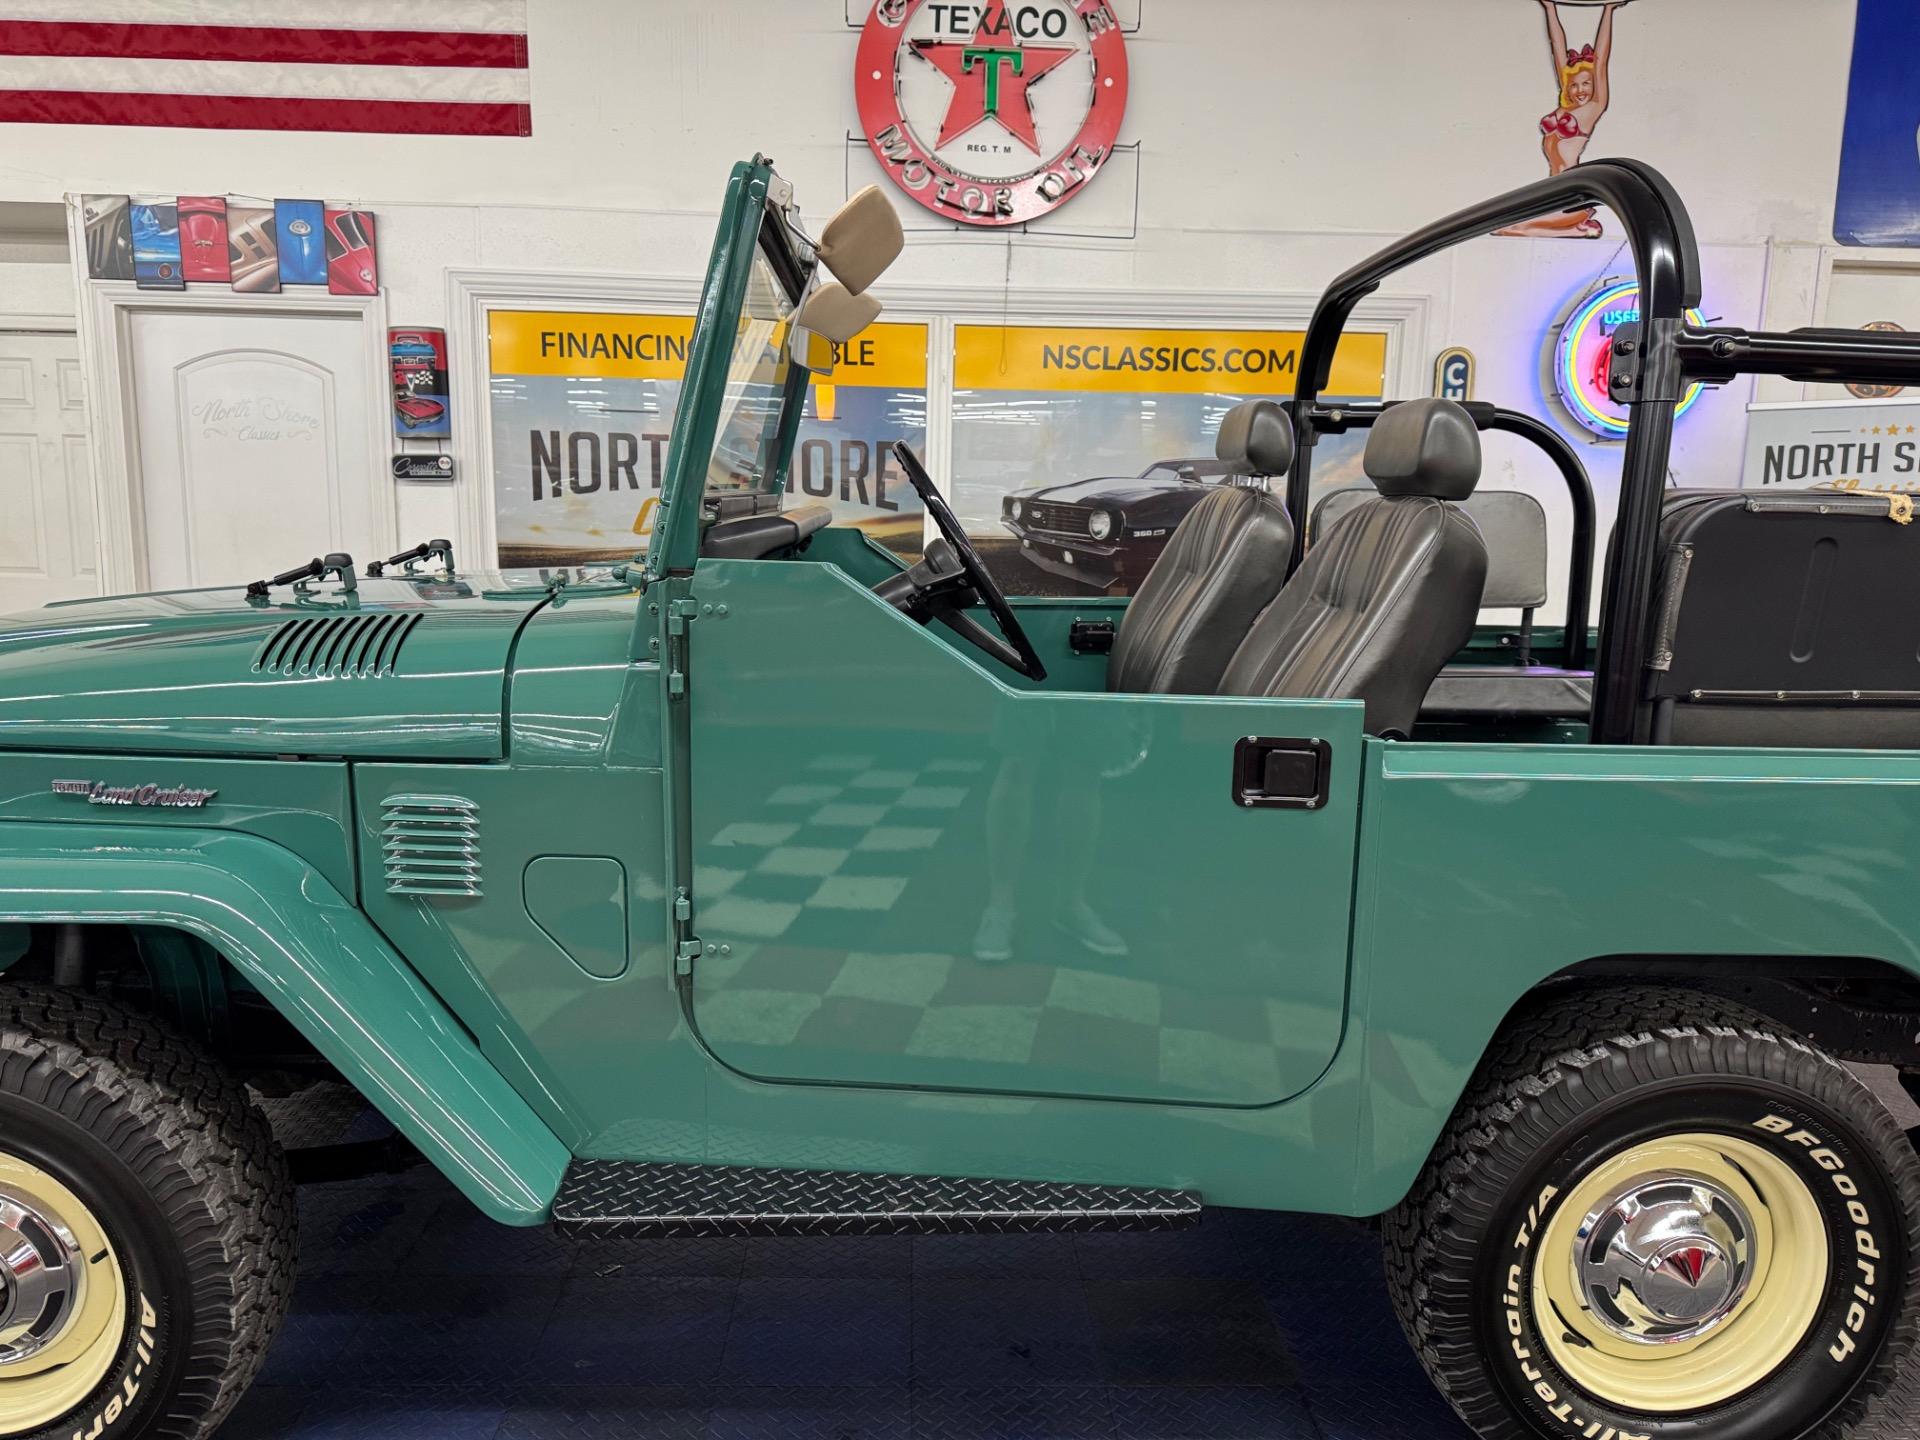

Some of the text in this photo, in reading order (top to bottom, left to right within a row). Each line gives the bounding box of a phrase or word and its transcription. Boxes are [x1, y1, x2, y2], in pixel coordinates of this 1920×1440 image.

[927, 5, 1067, 38] TEXACO
[874, 122, 1105, 220] MOTOR OIL
[540, 331, 694, 362] FINANCIN
[1042, 344, 1295, 375] NSCLASSICS.COM
[530, 429, 669, 501] NORT
[1763, 441, 1920, 485] NORTH S
[88, 781, 137, 805] Land
[138, 783, 219, 808] Cruiser
[1514, 1184, 1559, 1249] T/A
[1752, 1114, 1881, 1364] BFGoodrich
